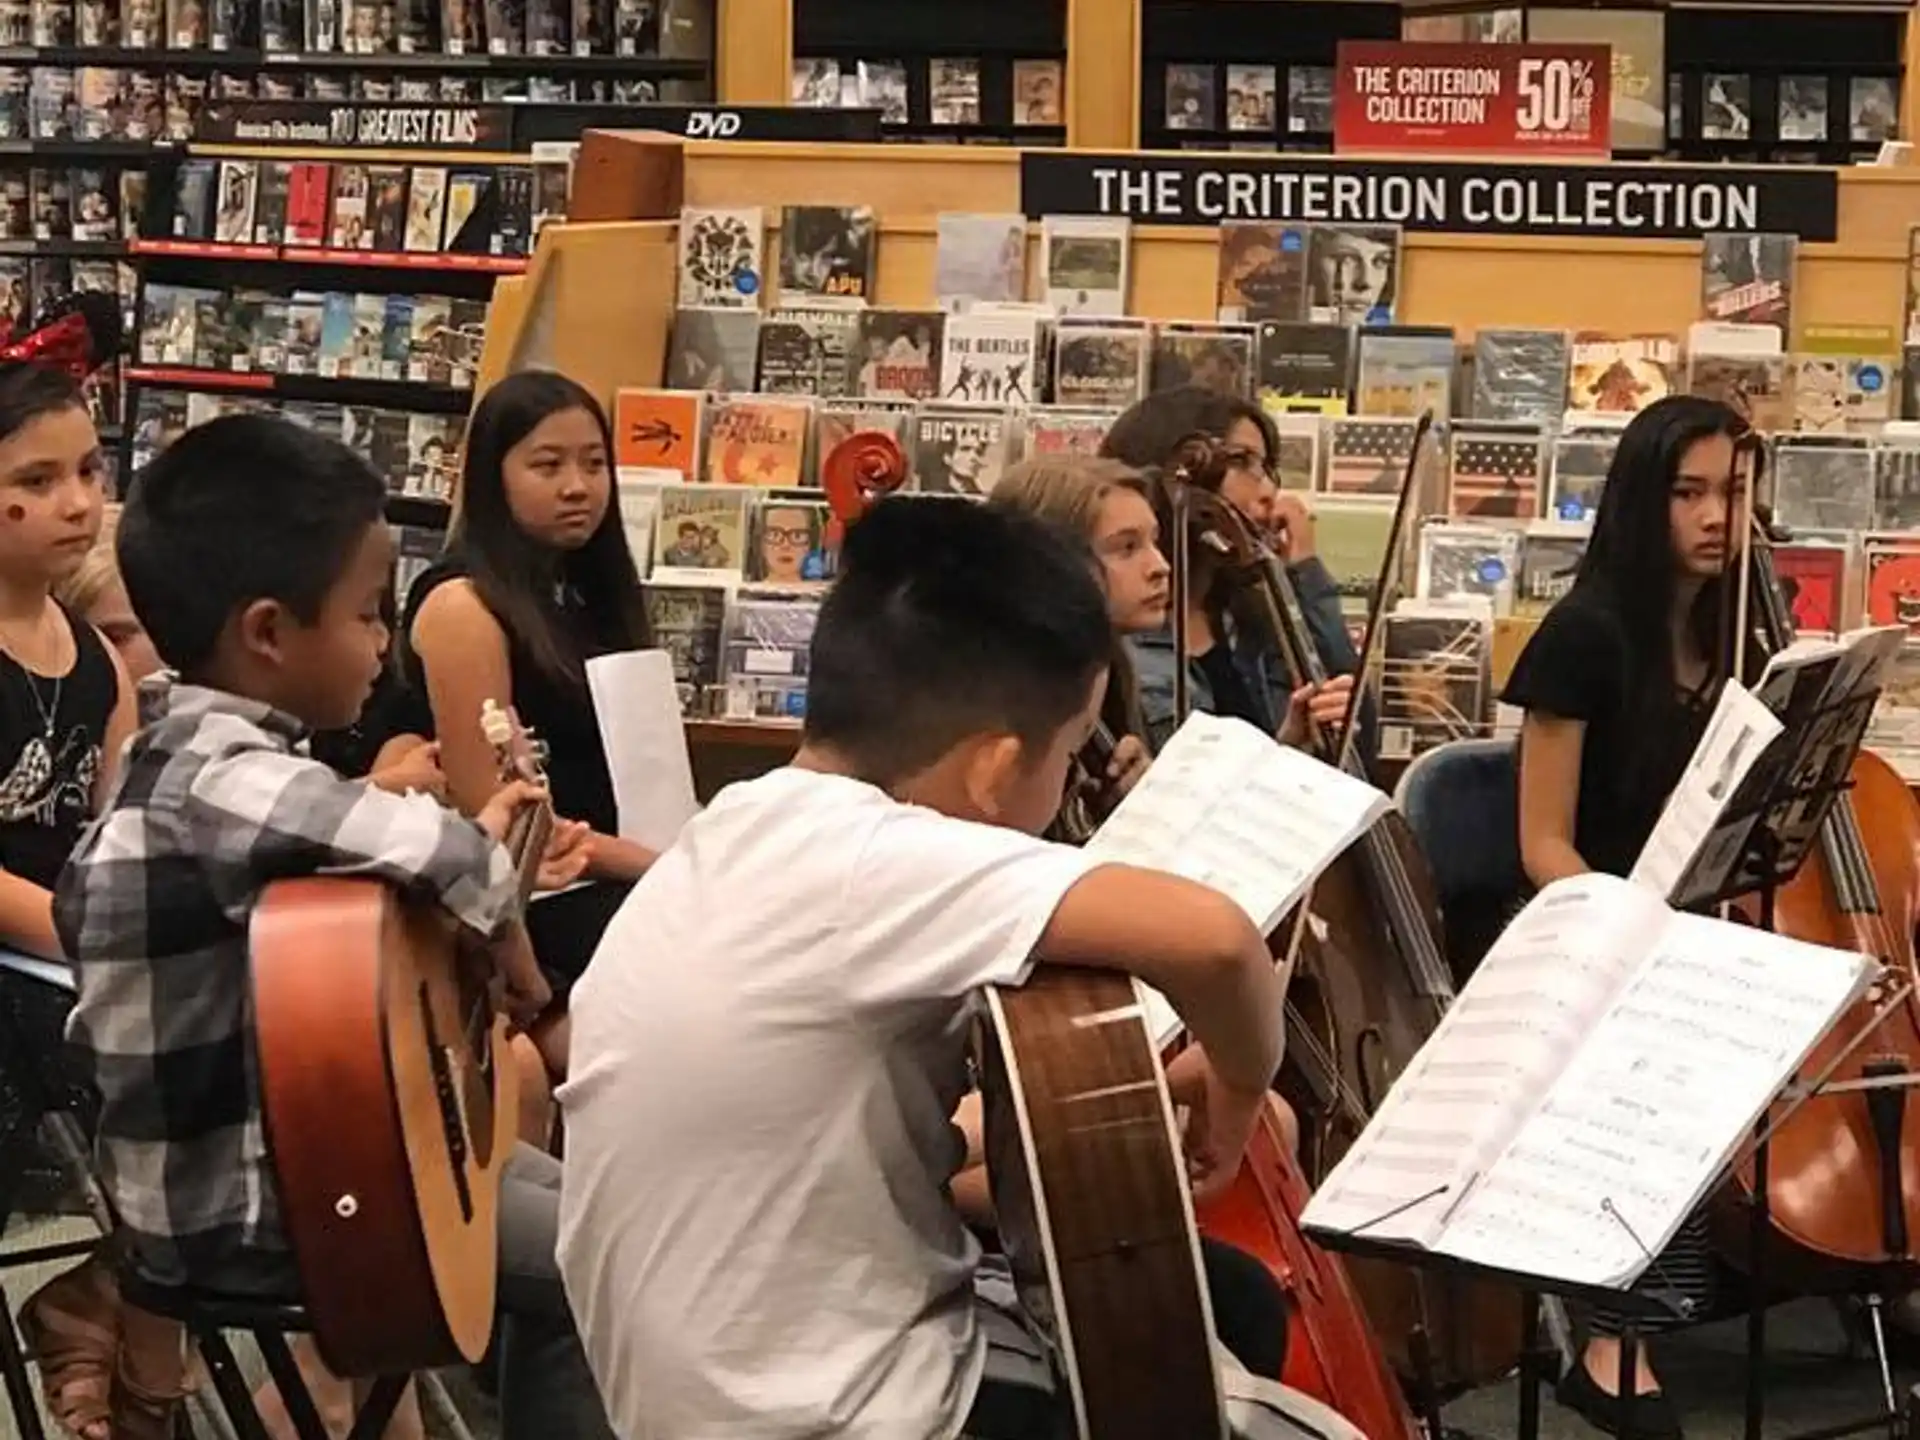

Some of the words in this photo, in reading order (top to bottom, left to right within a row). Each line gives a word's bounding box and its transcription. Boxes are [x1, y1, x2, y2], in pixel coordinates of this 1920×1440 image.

[1354, 66, 1390, 93] THE
[1397, 67, 1500, 95] CRITERION
[1366, 96, 1485, 124] COLLECTION
[331, 109, 354, 143] 100
[358, 109, 430, 143] GREATEST
[432, 109, 478, 143] FILMS
[686, 112, 740, 137] DVD
[1093, 169, 1183, 214] THE
[1196, 171, 1445, 221] CRITERION
[1462, 177, 1757, 229] COLLECTION
[976, 339, 1030, 353] BEATLES
[921, 421, 1000, 443] BICYCLE
